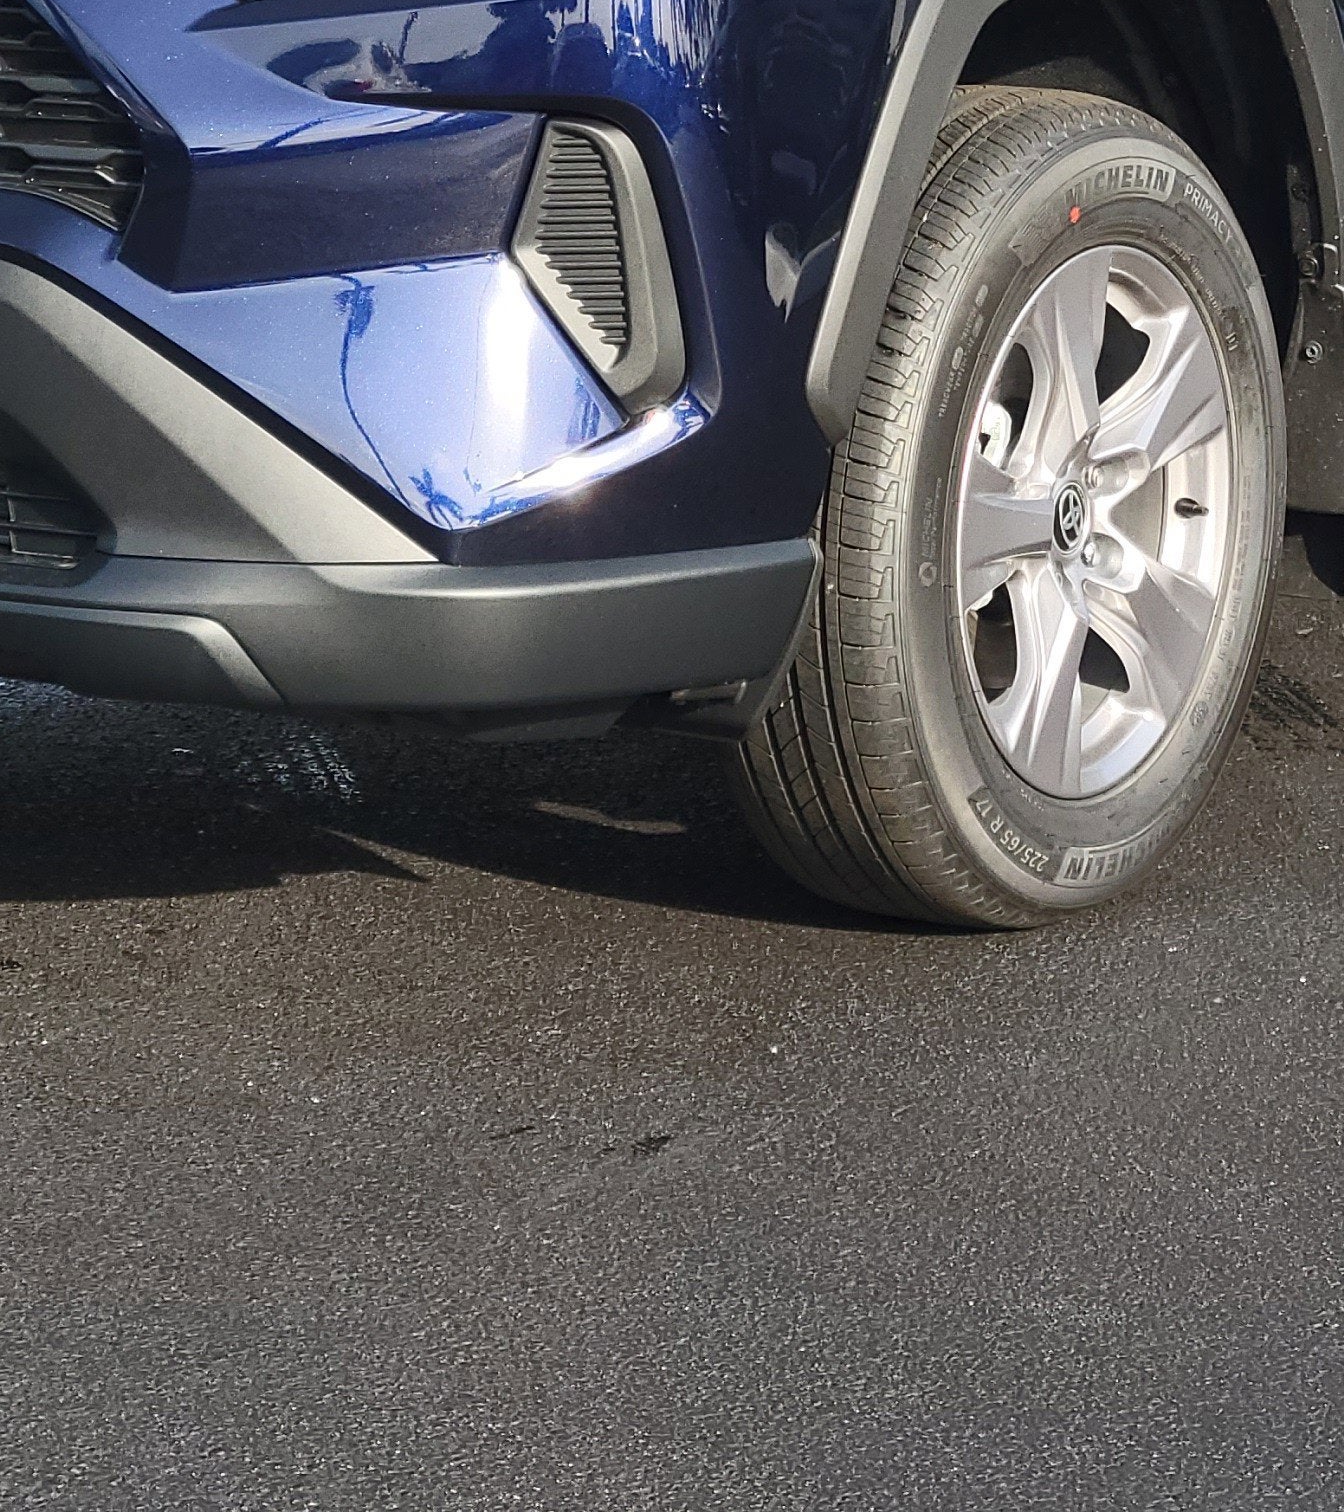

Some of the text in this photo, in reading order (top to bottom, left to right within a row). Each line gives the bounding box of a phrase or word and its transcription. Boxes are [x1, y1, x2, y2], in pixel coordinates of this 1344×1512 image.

[1064, 164, 1234, 244] MICHELIN PRIMACY
[975, 799, 1050, 873] 225/65 R 17
